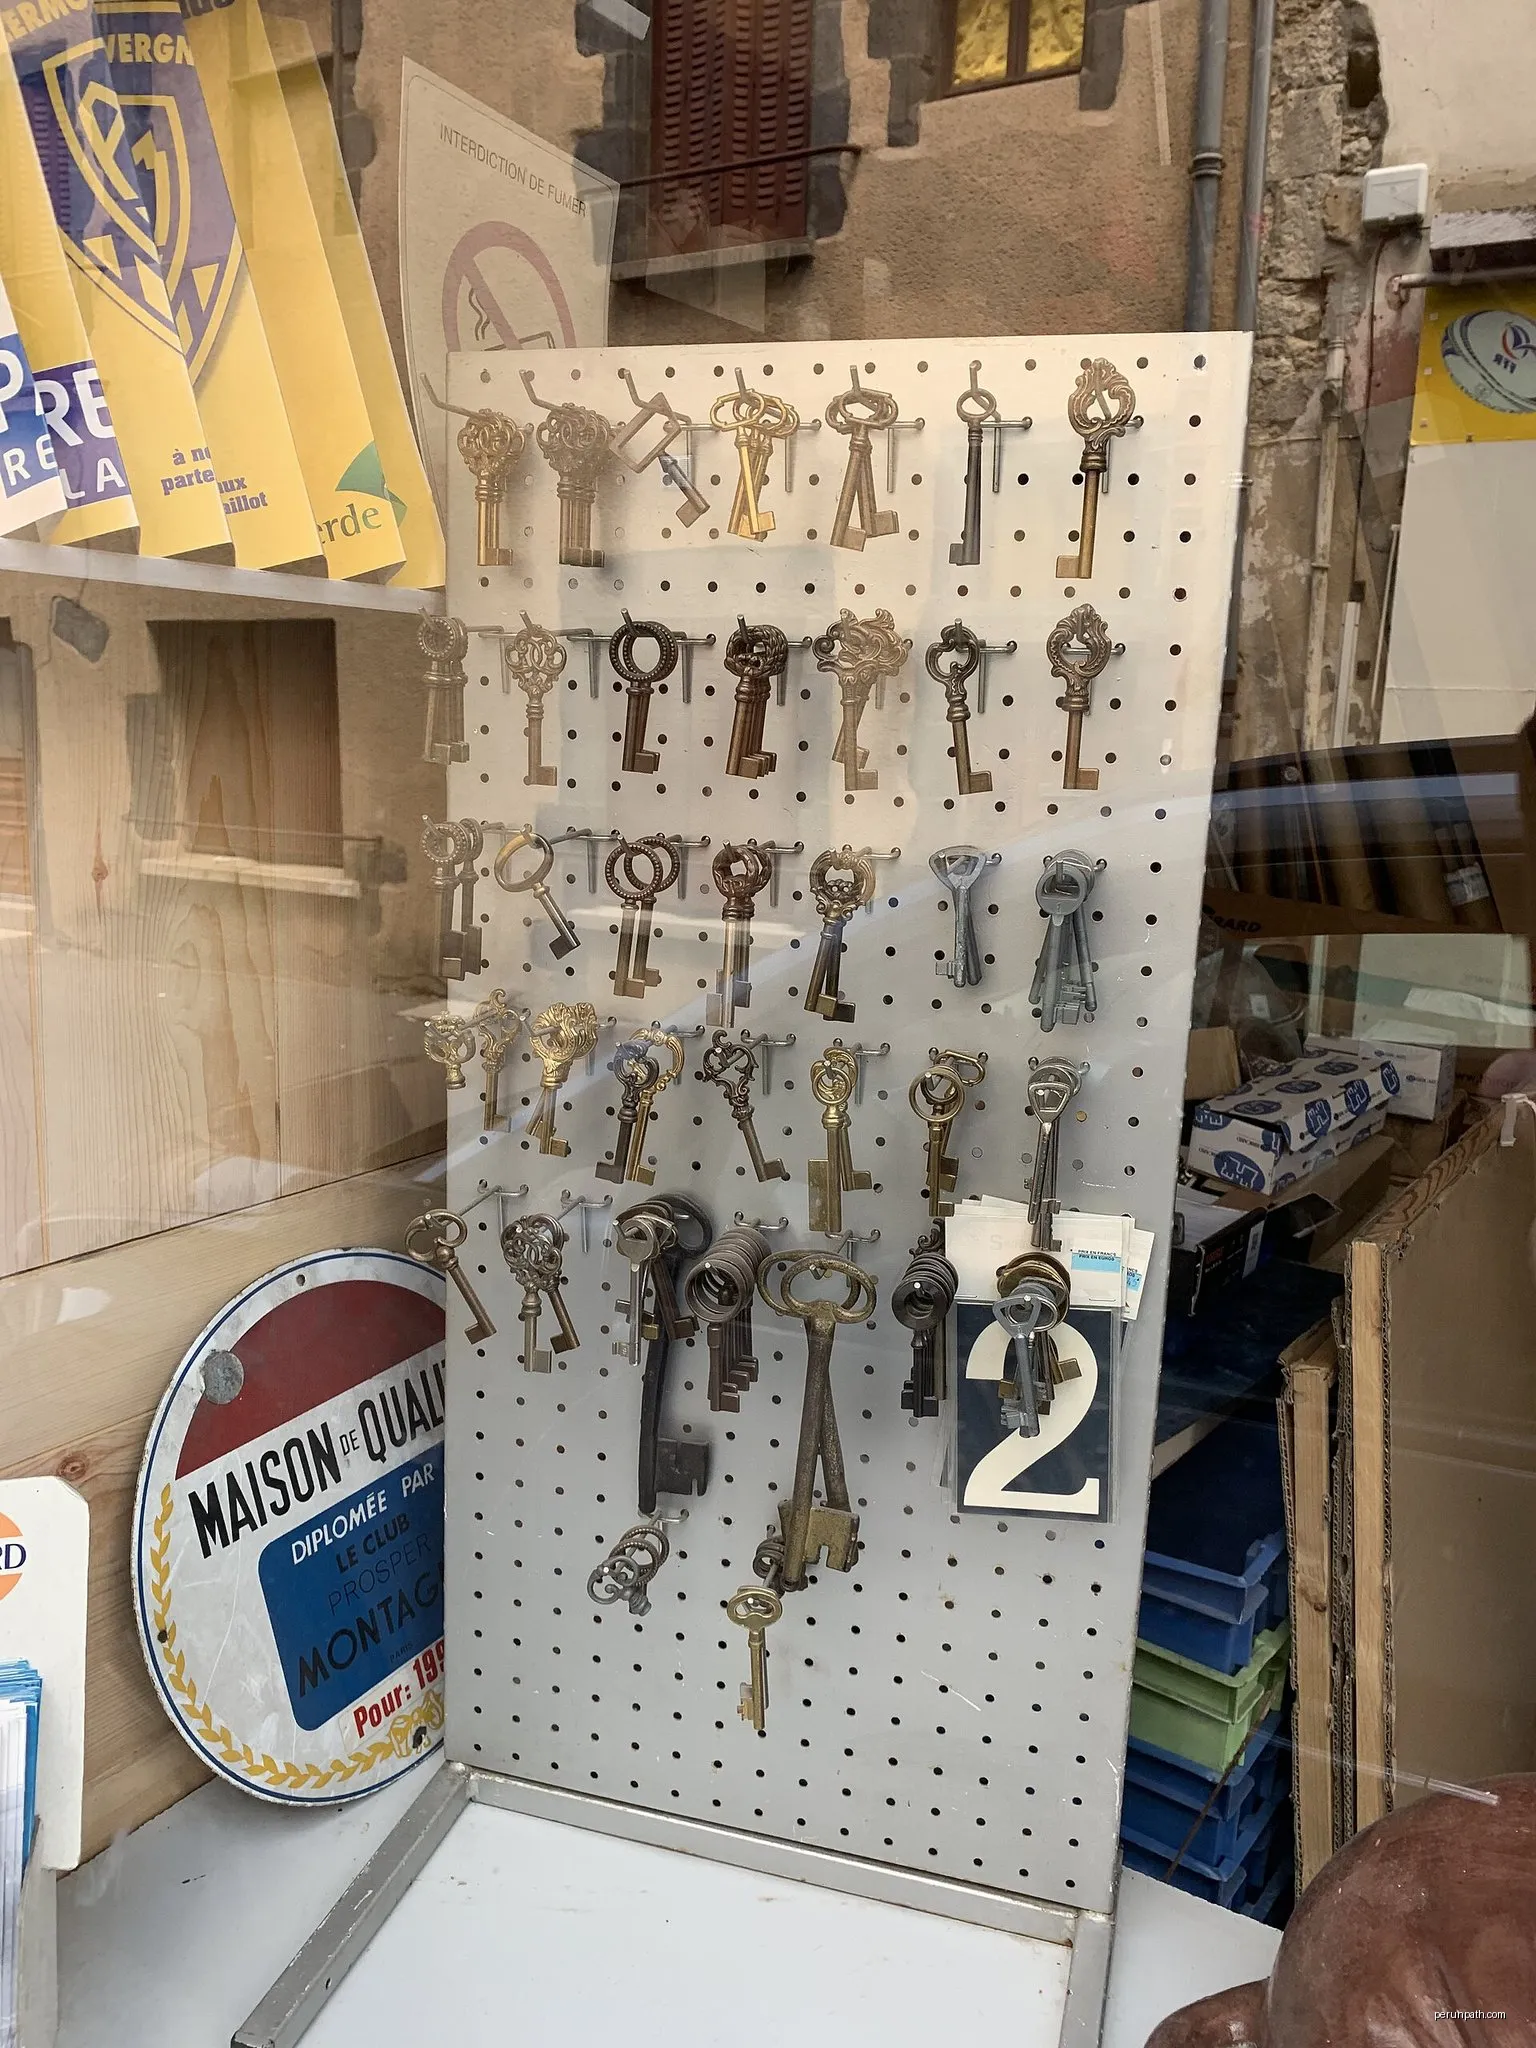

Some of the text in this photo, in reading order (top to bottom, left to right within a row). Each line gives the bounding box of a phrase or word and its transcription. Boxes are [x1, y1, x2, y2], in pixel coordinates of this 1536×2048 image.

[440, 124, 587, 217] INTERDICTION DE FUMER
[161, 468, 215, 496] parte
[172, 448, 186, 466] à
[963, 1318, 1100, 1515] 2
[188, 1422, 342, 1560] MAISON
[340, 1429, 360, 1455] DE
[291, 1463, 435, 1565] DIPLOMÉE PAR
[328, 1533, 432, 1616] PROSPER
[336, 1513, 411, 1574] LE CLUB
[299, 1562, 444, 1698] MONTAG
[390, 1641, 414, 1664] PARIS
[353, 1683, 412, 1738] Pour:
